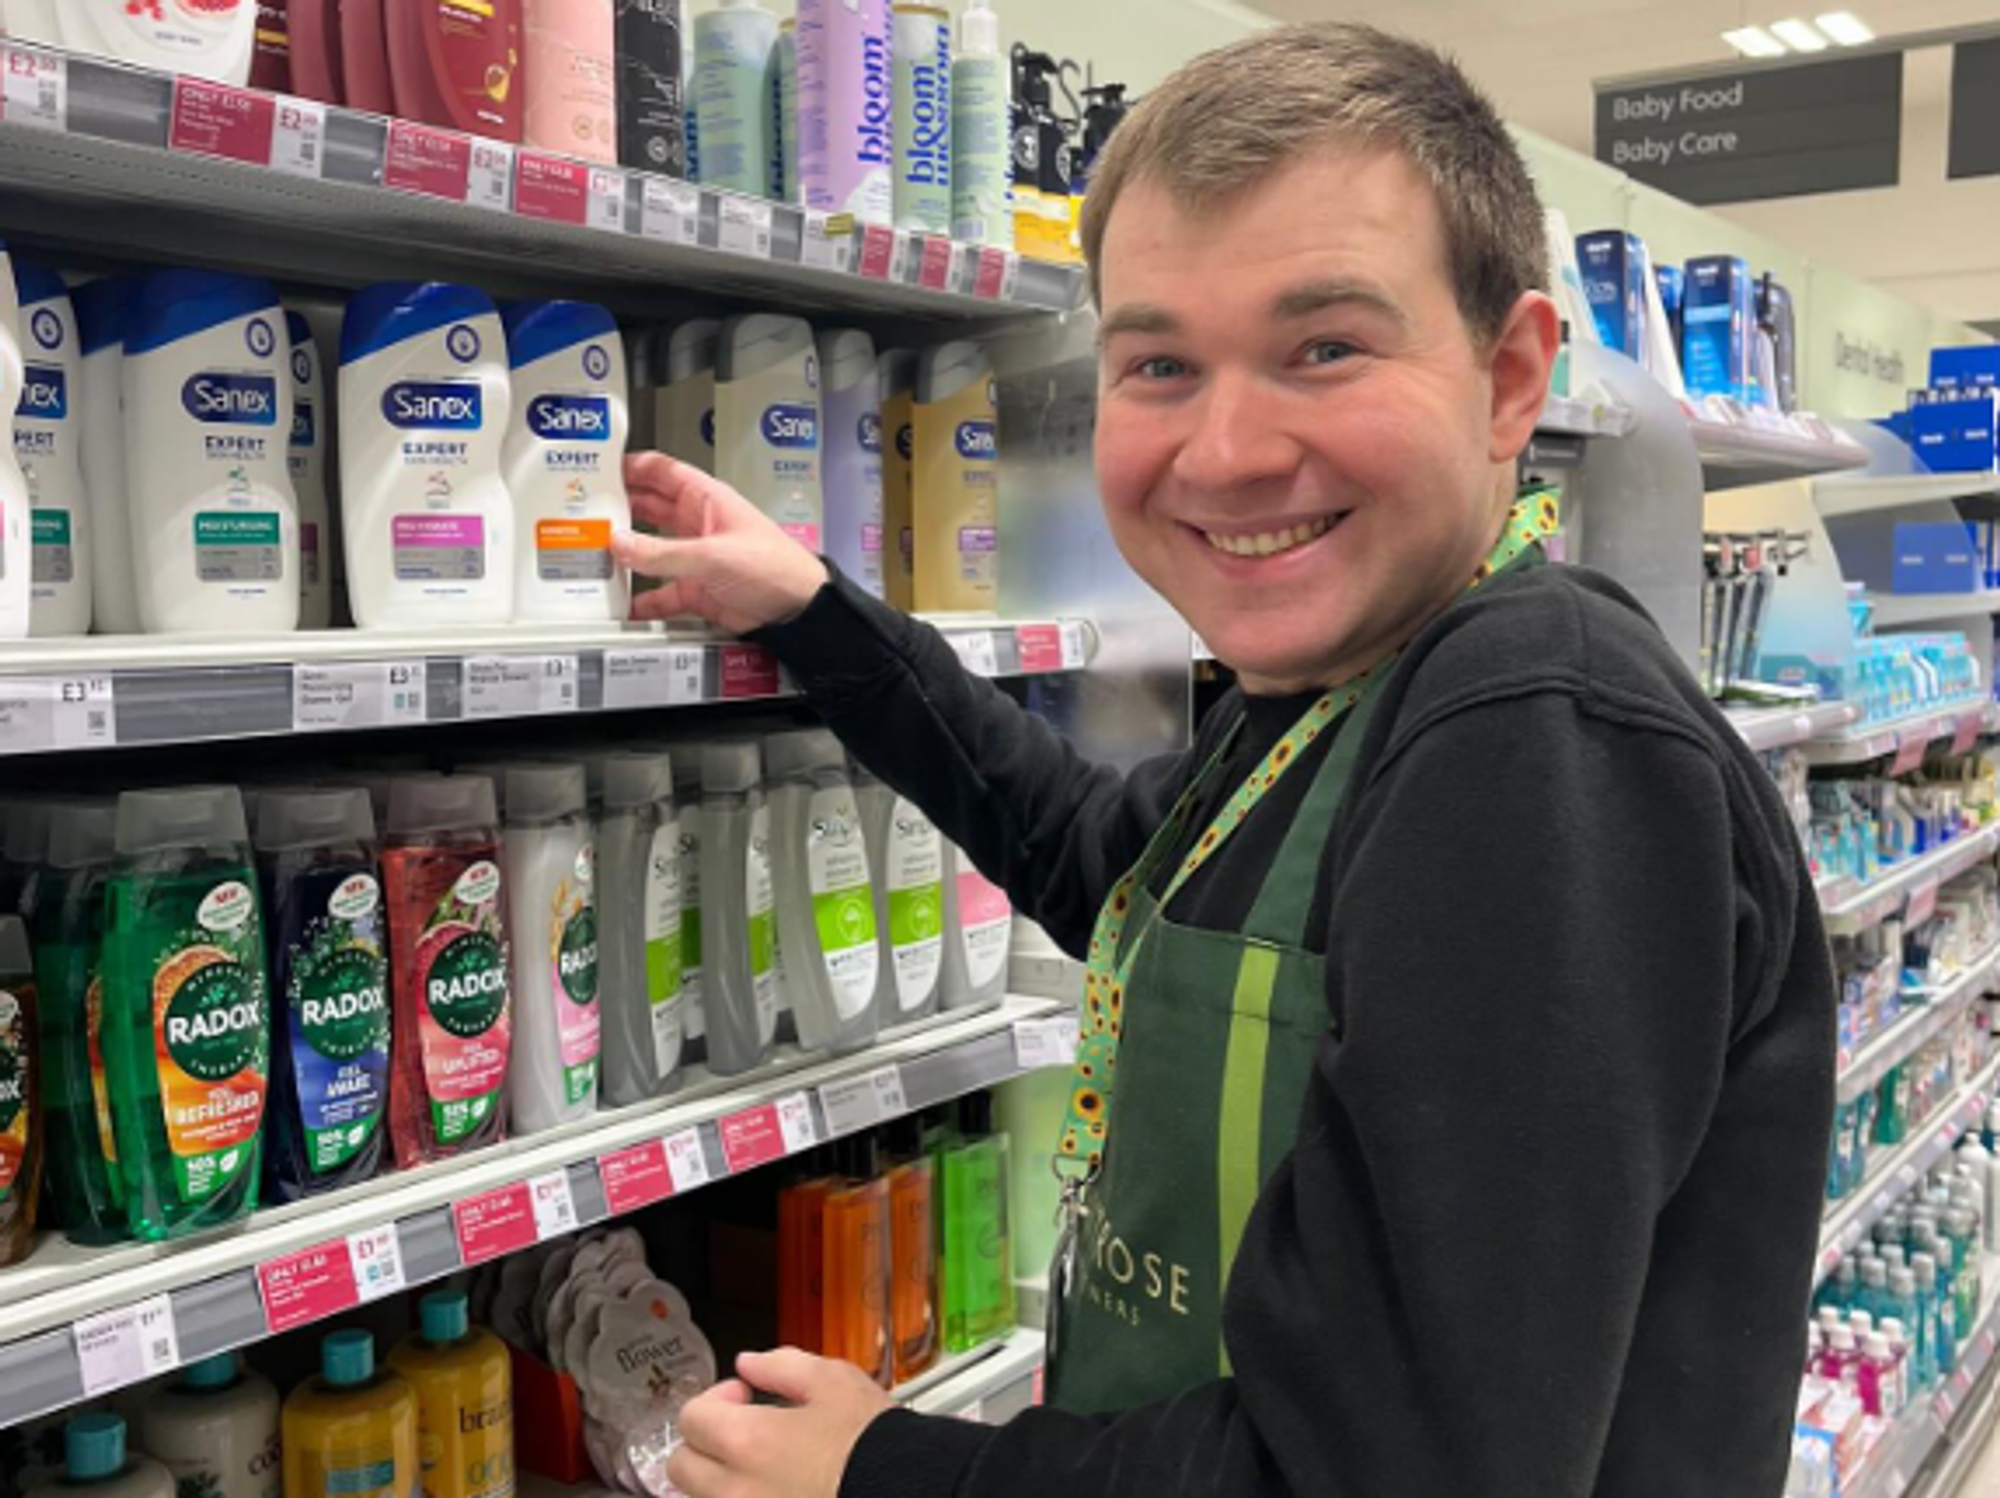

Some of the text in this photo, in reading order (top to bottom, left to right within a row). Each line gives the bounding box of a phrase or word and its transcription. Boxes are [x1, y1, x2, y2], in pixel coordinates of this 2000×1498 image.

[857, 37, 884, 162] bloom
[1613, 83, 1743, 121] Baby Food
[905, 65, 936, 184] bloom
[1613, 132, 1737, 164] Baby Care
[194, 380, 270, 413] Sanex
[394, 390, 474, 420] Sanex
[538, 403, 605, 430] Sanex
[14, 429, 54, 447] PERT
[205, 435, 266, 451] EXPERT
[403, 443, 467, 456] EXPERT
[546, 452, 599, 465] EXPERT
[429, 968, 507, 1005] RADOX
[302, 986, 384, 1025] RADOX
[168, 1000, 259, 1045] RADOX
